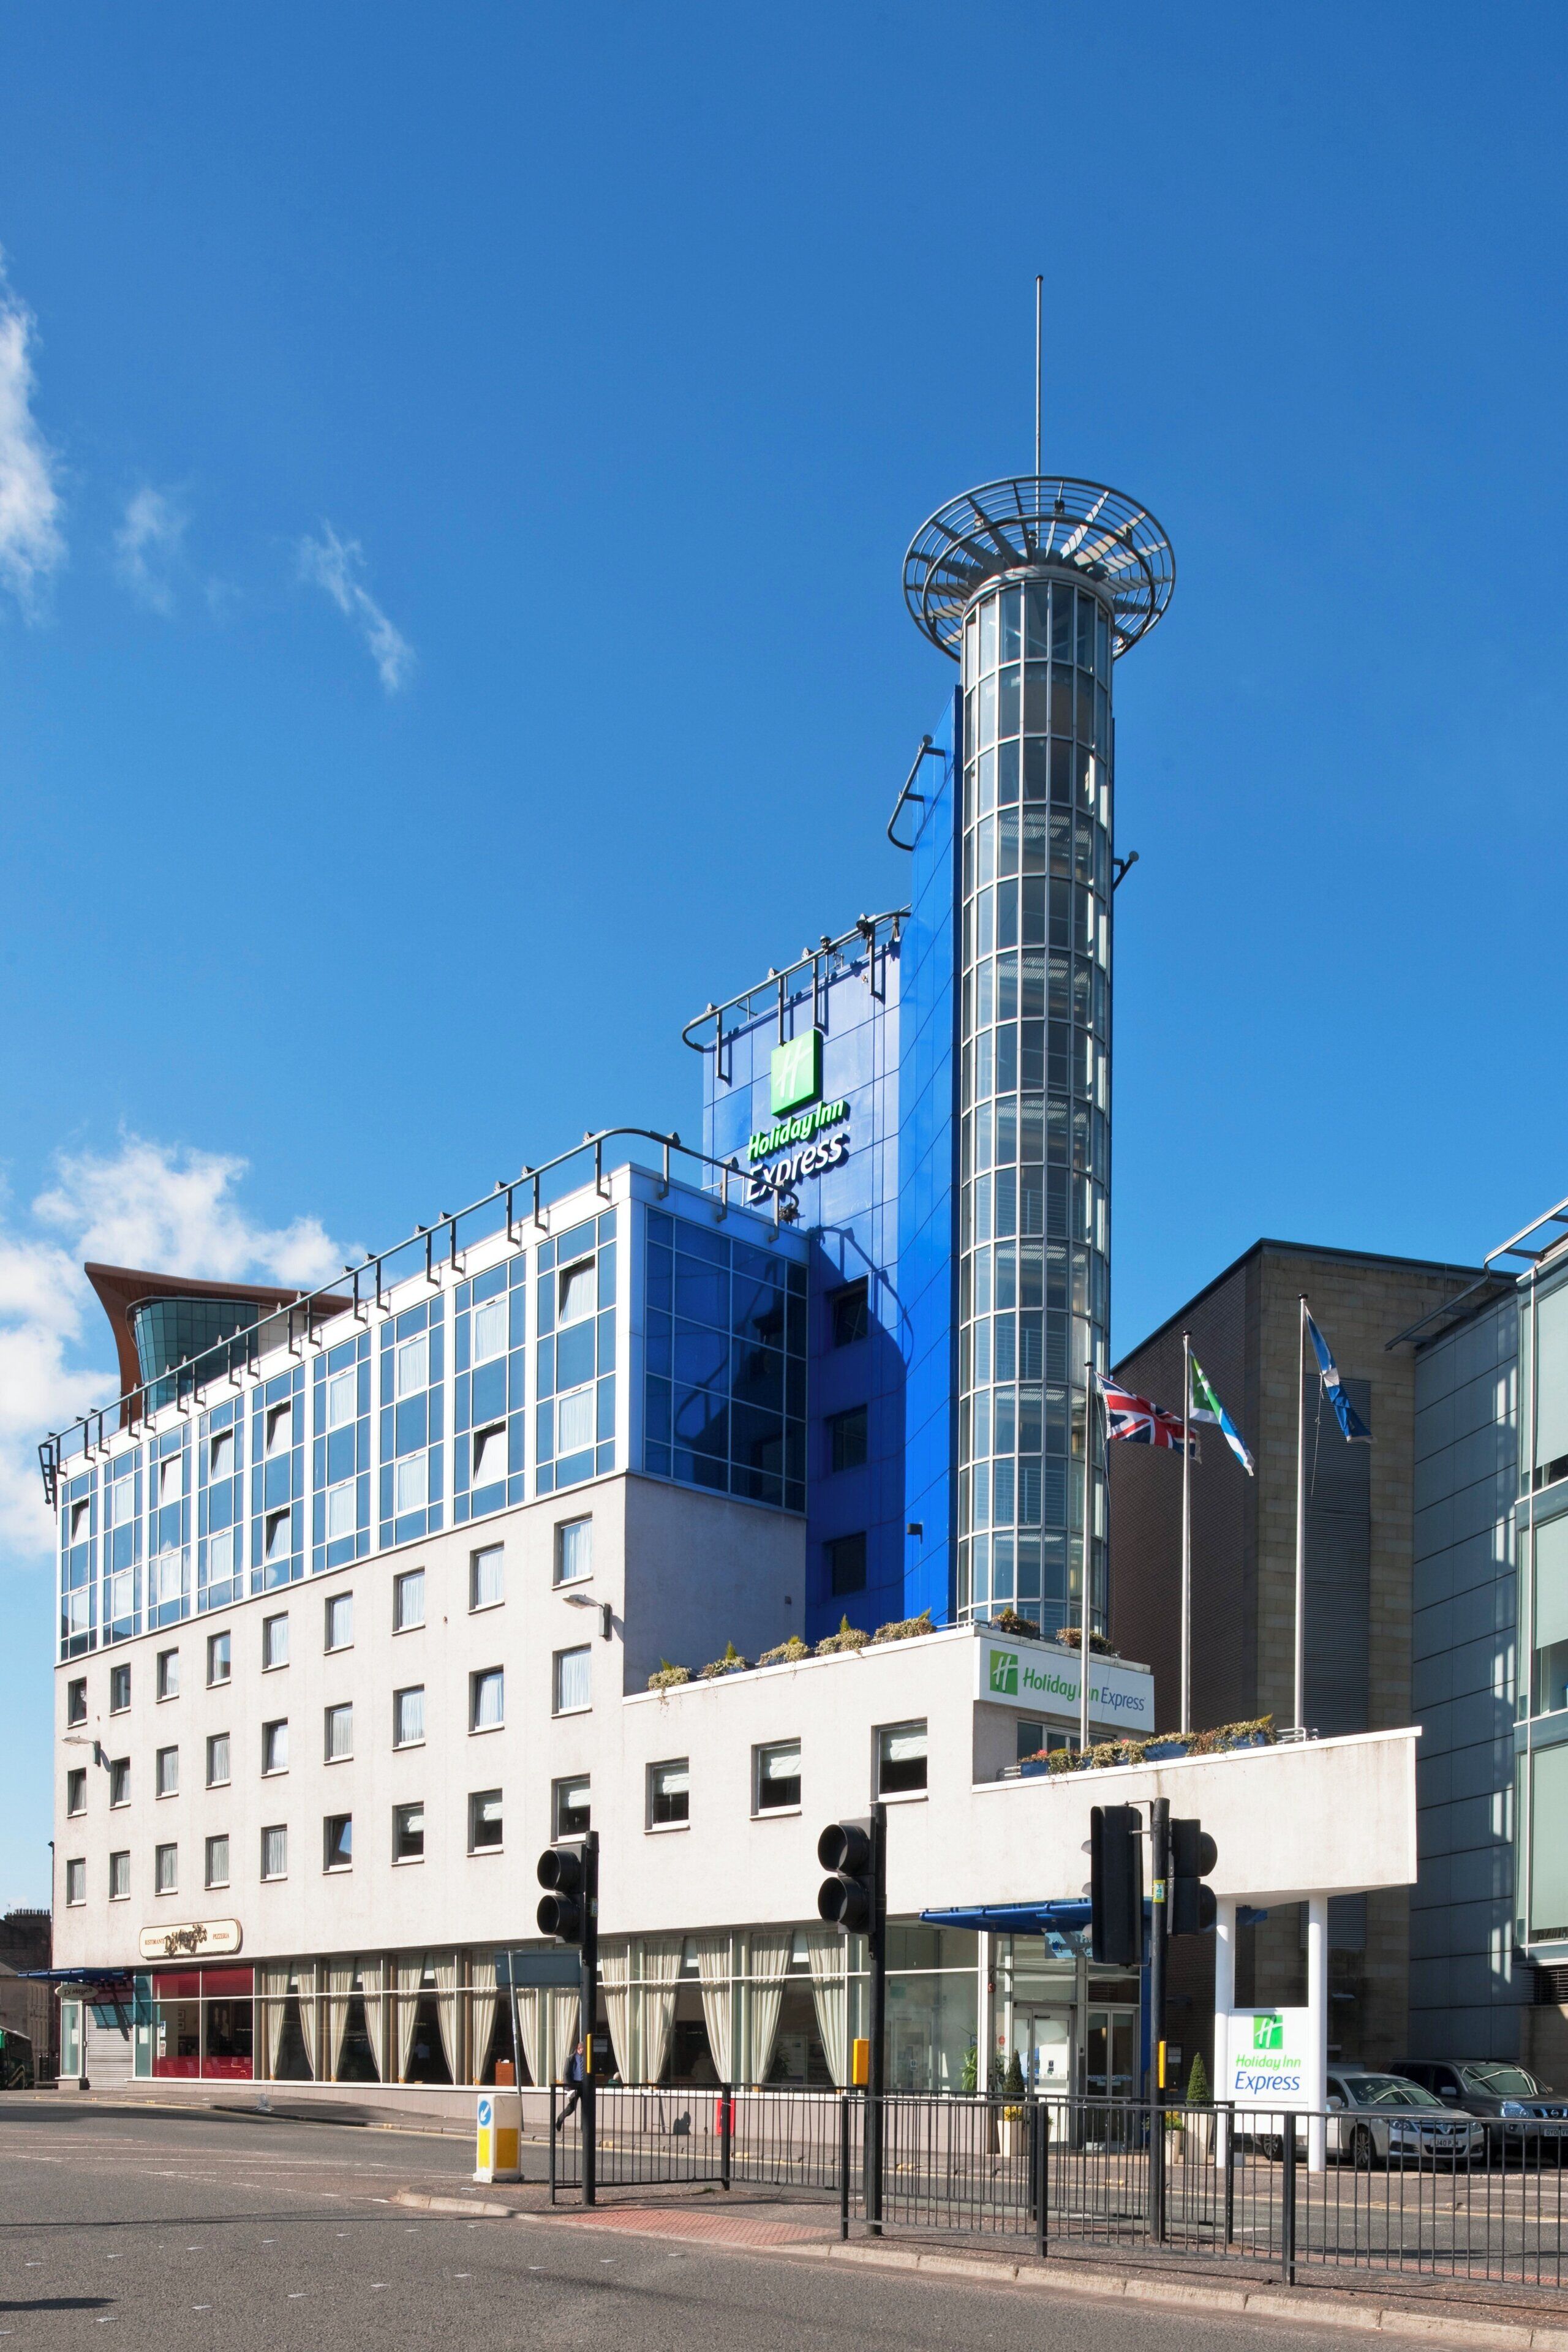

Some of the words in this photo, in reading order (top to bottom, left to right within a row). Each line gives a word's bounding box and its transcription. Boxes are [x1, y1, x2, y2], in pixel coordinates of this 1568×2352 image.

[747, 1117, 812, 1161] Holiday
[815, 1099, 843, 1129] Inn
[746, 1133, 843, 1202] Express
[1022, 1667, 1077, 1702] Holiday
[1079, 1679, 1099, 1702] In
[1101, 1687, 1145, 1711] Express
[1235, 2054, 1281, 2071] Holiday
[1283, 2054, 1301, 2068] Inn
[1235, 2071, 1300, 2095] Express
